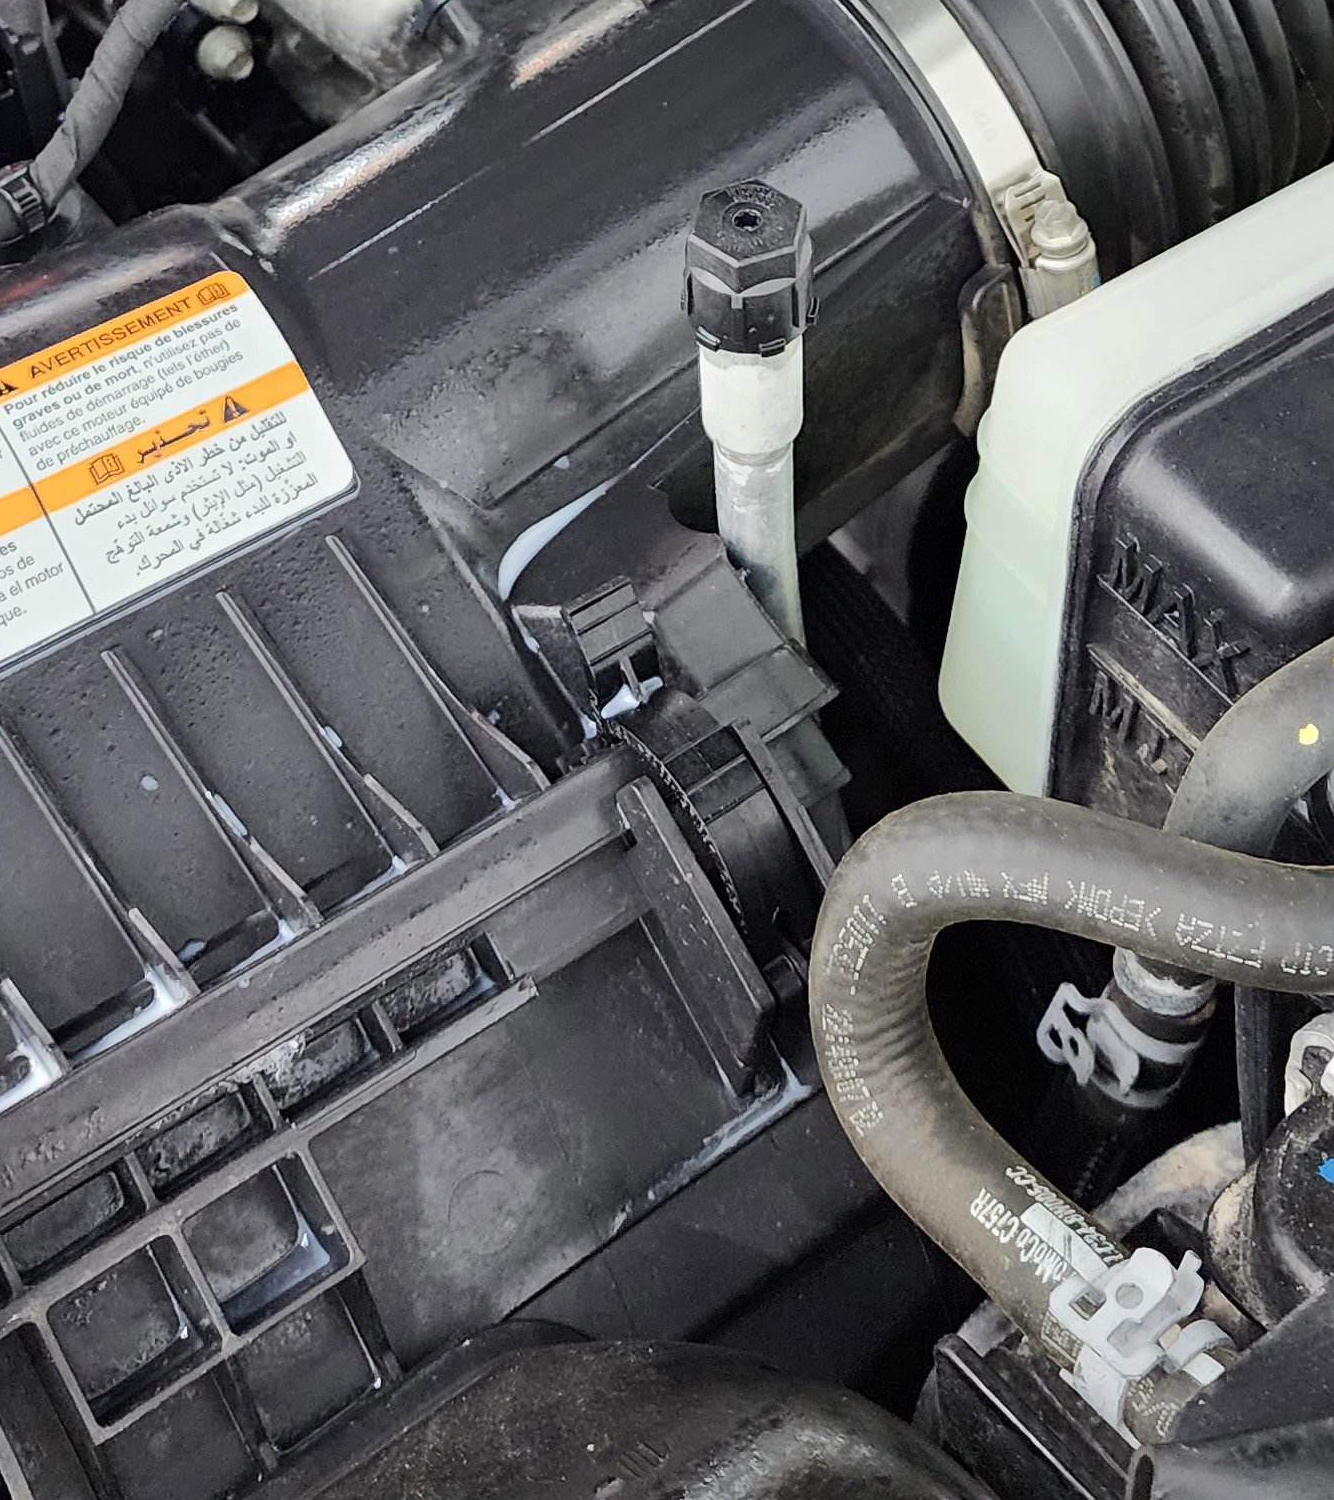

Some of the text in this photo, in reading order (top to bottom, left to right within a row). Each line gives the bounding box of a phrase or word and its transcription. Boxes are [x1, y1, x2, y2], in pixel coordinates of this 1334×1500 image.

[2, 303, 239, 416] Pour réduire le risque de blessures
[11, 400, 61, 431] graves
[62, 390, 82, 405] ou
[83, 381, 103, 395] de
[103, 364, 142, 387] mort,
[198, 327, 223, 346] pas
[223, 318, 241, 332] de
[29, 295, 192, 380] AVERTISSEMENT
[18, 416, 65, 442] fluides
[65, 407, 84, 421] de
[85, 374, 156, 412] démarrage
[156, 361, 186, 381] (tels
[27, 350, 244, 457] avec ce moteur équipé de bougies
[35, 416, 146, 471] de préchauffage.
[8, 579, 23, 597] el
[23, 561, 64, 589] motor
[15, 554, 35, 570] de
[1103, 532, 1251, 698] MAX
[1017, 1224, 1072, 1284] oMoCo
